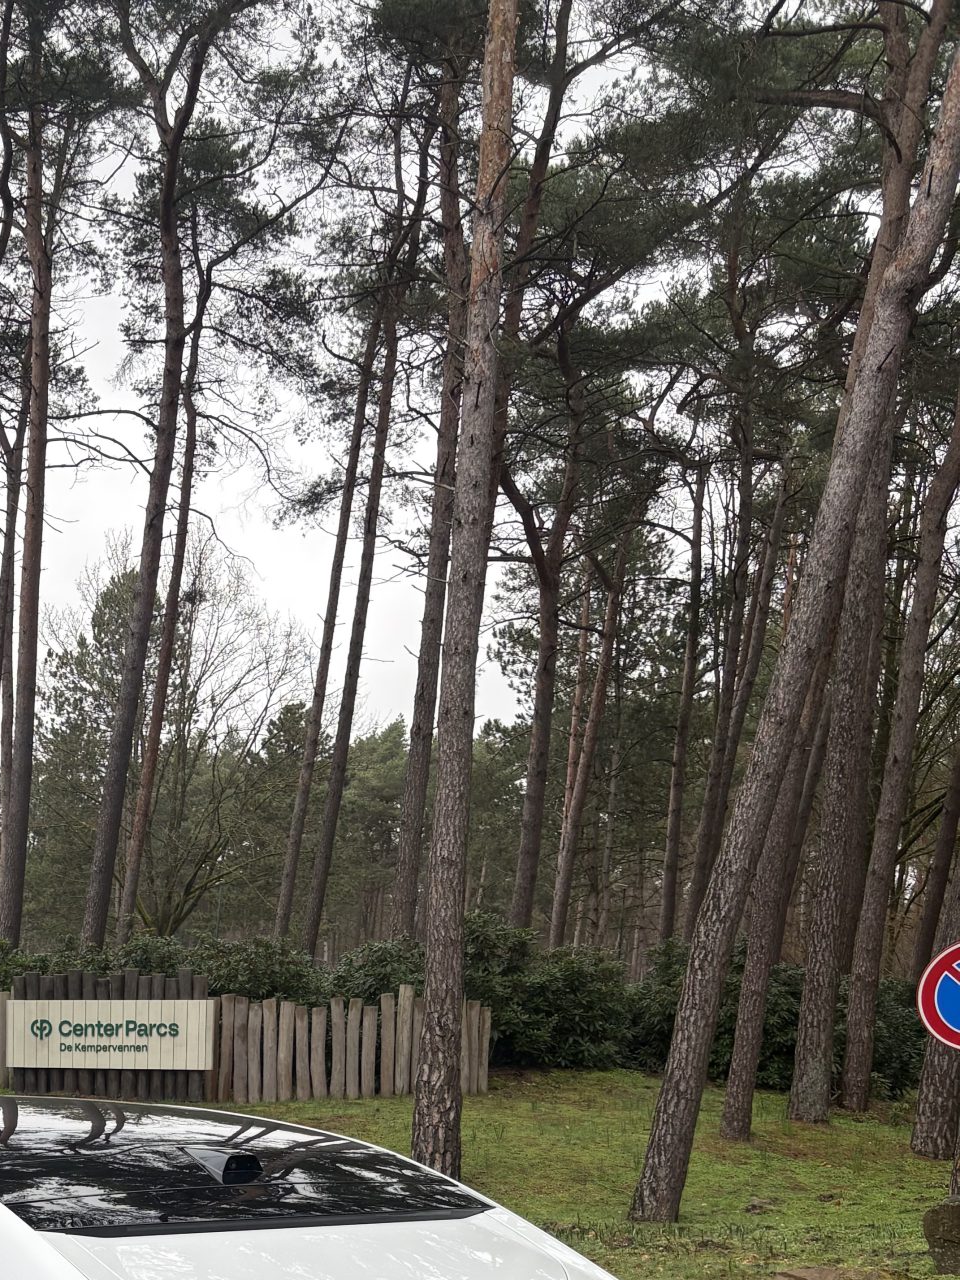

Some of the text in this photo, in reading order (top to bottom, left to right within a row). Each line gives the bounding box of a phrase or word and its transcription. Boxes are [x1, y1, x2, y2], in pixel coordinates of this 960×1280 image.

[58, 1019, 179, 1038] Center Parcs
[59, 1042, 148, 1054] De Kempervennen
